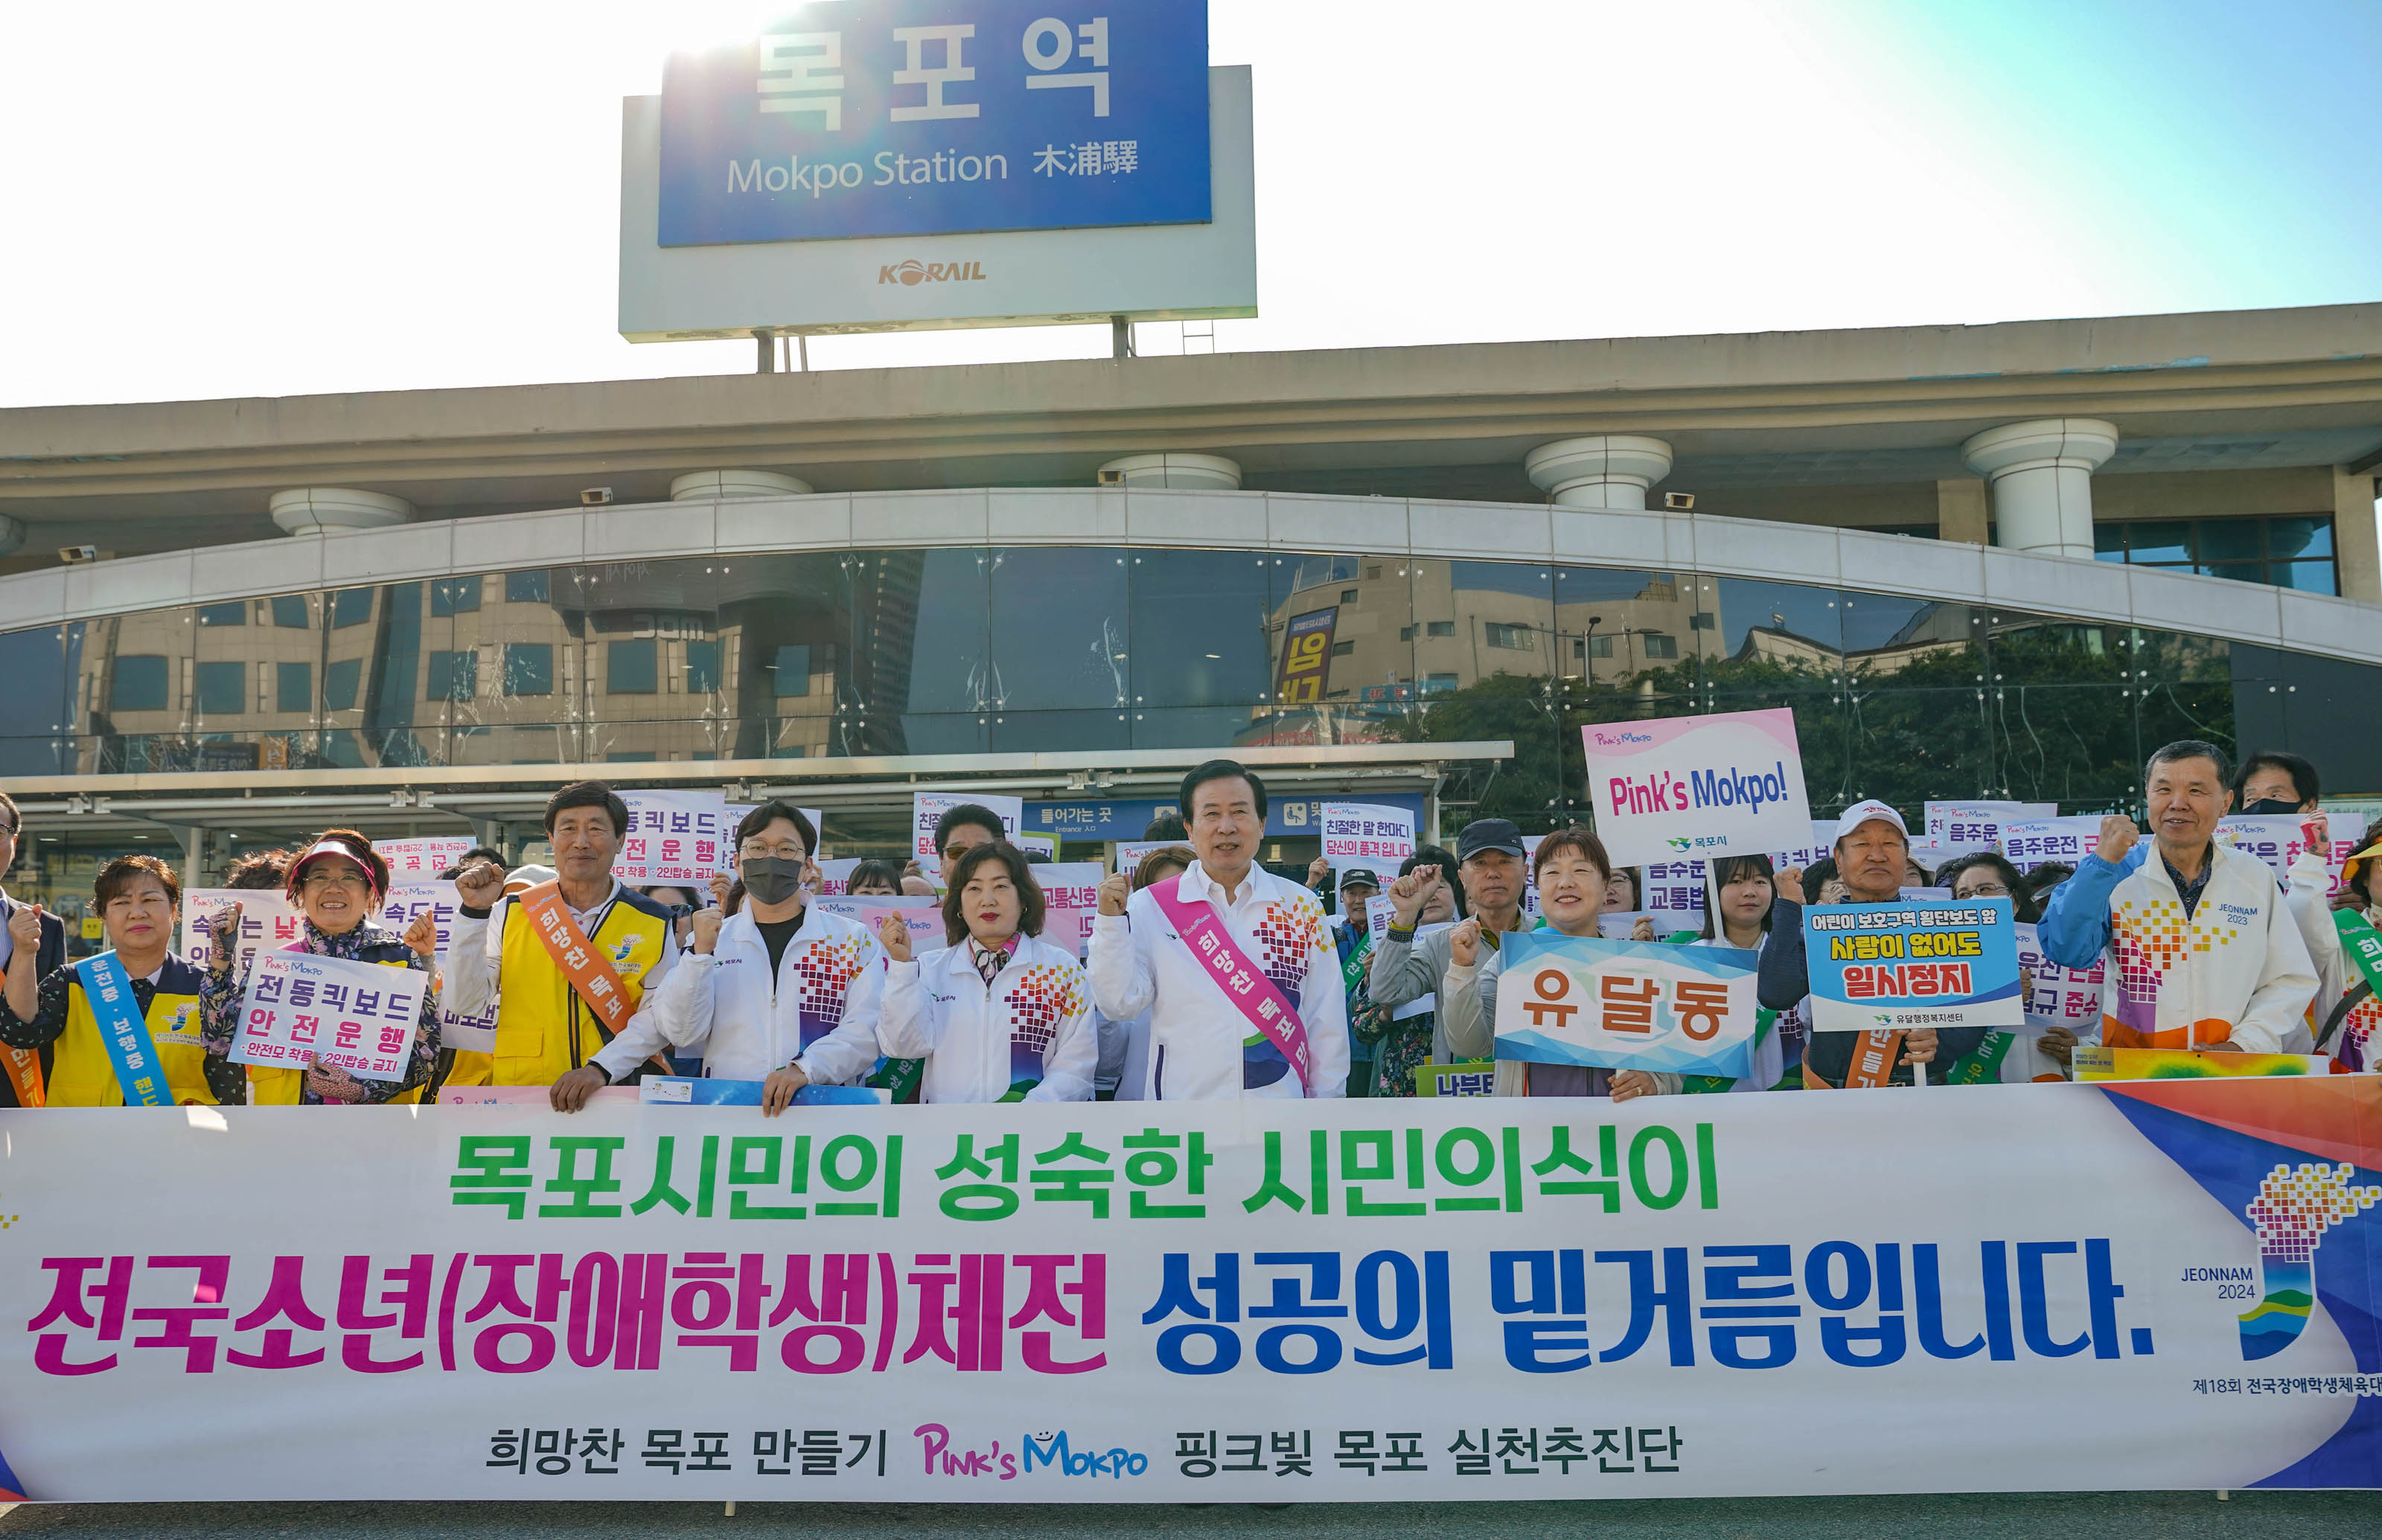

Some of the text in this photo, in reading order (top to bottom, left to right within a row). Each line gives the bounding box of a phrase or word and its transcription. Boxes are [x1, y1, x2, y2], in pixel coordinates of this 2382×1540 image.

[756, 16, 1111, 131] 목포역
[727, 148, 1009, 199] Mokpo Station
[878, 259, 987, 287] KORAIL
[1595, 732, 1652, 746] Pink's Mokpo
[1609, 761, 1789, 817] Pink's Mokpo!
[626, 811, 716, 834] 동킥보드
[1041, 807, 1112, 824] 들어가는 곳
[1326, 819, 1361, 835] 친절한
[1363, 821, 1376, 836] 말
[1377, 821, 1410, 839] 한마디
[1950, 823, 1998, 842] 음주운
[2235, 823, 2266, 834] Mokpo
[626, 838, 716, 863] 전운행
[1326, 840, 1412, 857] 당신의 품격 입니다
[1694, 834, 1728, 849] 목포시
[2007, 835, 2078, 857] 음주운전
[628, 866, 648, 878] 착용
[657, 866, 692, 878] 2인탑승
[695, 867, 715, 880] 금지
[828, 903, 855, 913] Mokpo
[1649, 886, 1704, 910] 교통법
[2218, 903, 2258, 916] JEONNAM
[191, 915, 263, 941] 속는
[1811, 907, 1998, 932] 어린이 보호구역 횡단보도 앞
[2227, 914, 2248, 926] 2023
[1829, 930, 1983, 962] 사람이 없어도
[264, 955, 290, 972] Pink's
[290, 962, 322, 976] Mokpo
[540, 907, 590, 971] 희망찬
[587, 974, 624, 1020] 목포
[2019, 951, 2061, 981] 운전
[1197, 929, 1256, 995] 희망찬
[1256, 996, 1296, 1043] 목포
[1842, 962, 1973, 999] 일시정지
[255, 974, 412, 1021] 전동킥보드
[1523, 969, 1729, 1041] 유달동
[2065, 991, 2099, 1017] 준수
[1896, 1012, 1964, 1025] 유달행정복지센터
[246, 1042, 286, 1059] 안전모
[288, 1047, 314, 1063] 착용
[372, 1059, 398, 1073] 금지
[450, 1122, 1719, 1221] 목포시민의 성숙한 시민의식이
[2180, 1267, 2254, 1282] JEONNAM
[2217, 1284, 2256, 1300] 2024
[28, 1237, 2155, 1376] 전국소년(장애학생)체전 성공의 밑거름입니다.
[2192, 1377, 2382, 1395] 제18회 전국장애학생체육대
[485, 1422, 1683, 1480] 희망찬 목포 만들기 Pink's Mokpo 핑크빛 목포 실천추진단
